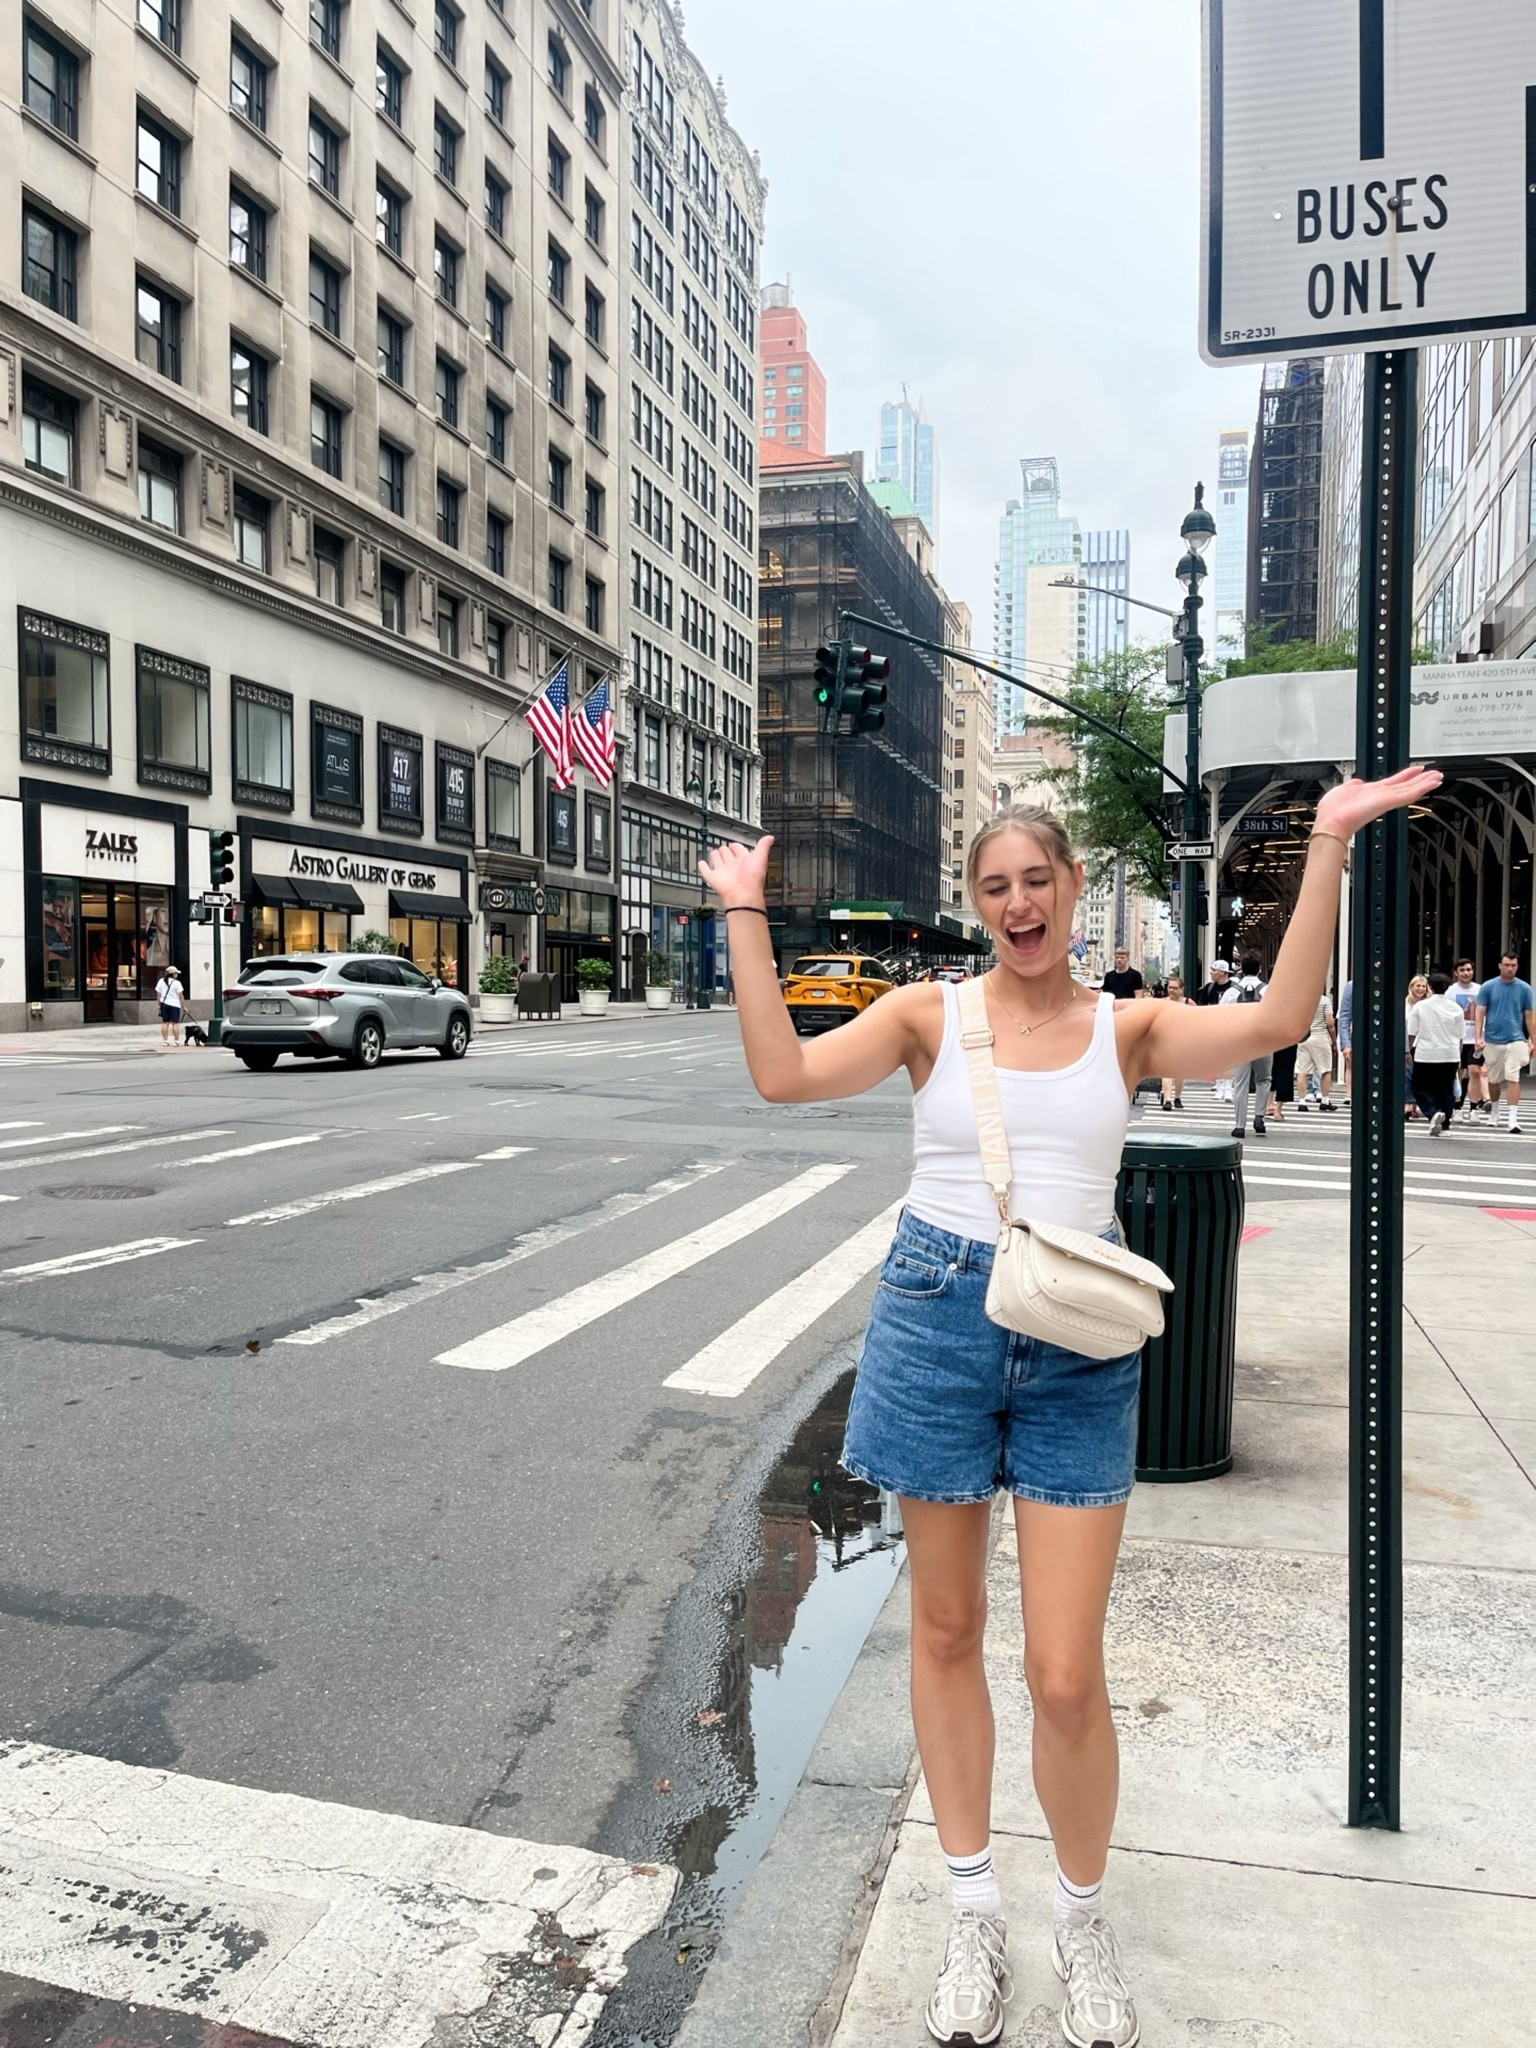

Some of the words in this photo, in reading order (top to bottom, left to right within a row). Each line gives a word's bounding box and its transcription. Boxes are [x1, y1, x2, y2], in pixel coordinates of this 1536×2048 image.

[1298, 174, 1448, 244] BUSES
[1308, 252, 1436, 320] ONLY
[1224, 326, 1276, 341] SR-2331
[1422, 670, 1480, 681] MANHATTAN
[1482, 668, 1498, 677] 420
[1500, 667, 1518, 677] 5TH
[1443, 691, 1489, 701] URBAN
[1495, 689, 1533, 699] UMBR
[1454, 705, 1477, 714] (646)
[1479, 703, 1522, 713] 798-7276
[393, 756, 409, 780] 417
[448, 767, 464, 794] 415
[391, 793, 411, 804] EVENT
[391, 801, 411, 812] SPACE
[1243, 820, 1268, 831] 38th
[1271, 819, 1284, 831] St
[86, 829, 138, 855] ZALES
[1173, 847, 1188, 855] ONE
[1194, 847, 1209, 855] WAY
[289, 848, 334, 877] ASTRO
[391, 869, 406, 886] OF
[408, 872, 436, 890] GEMS
[492, 894, 503, 902] 417
